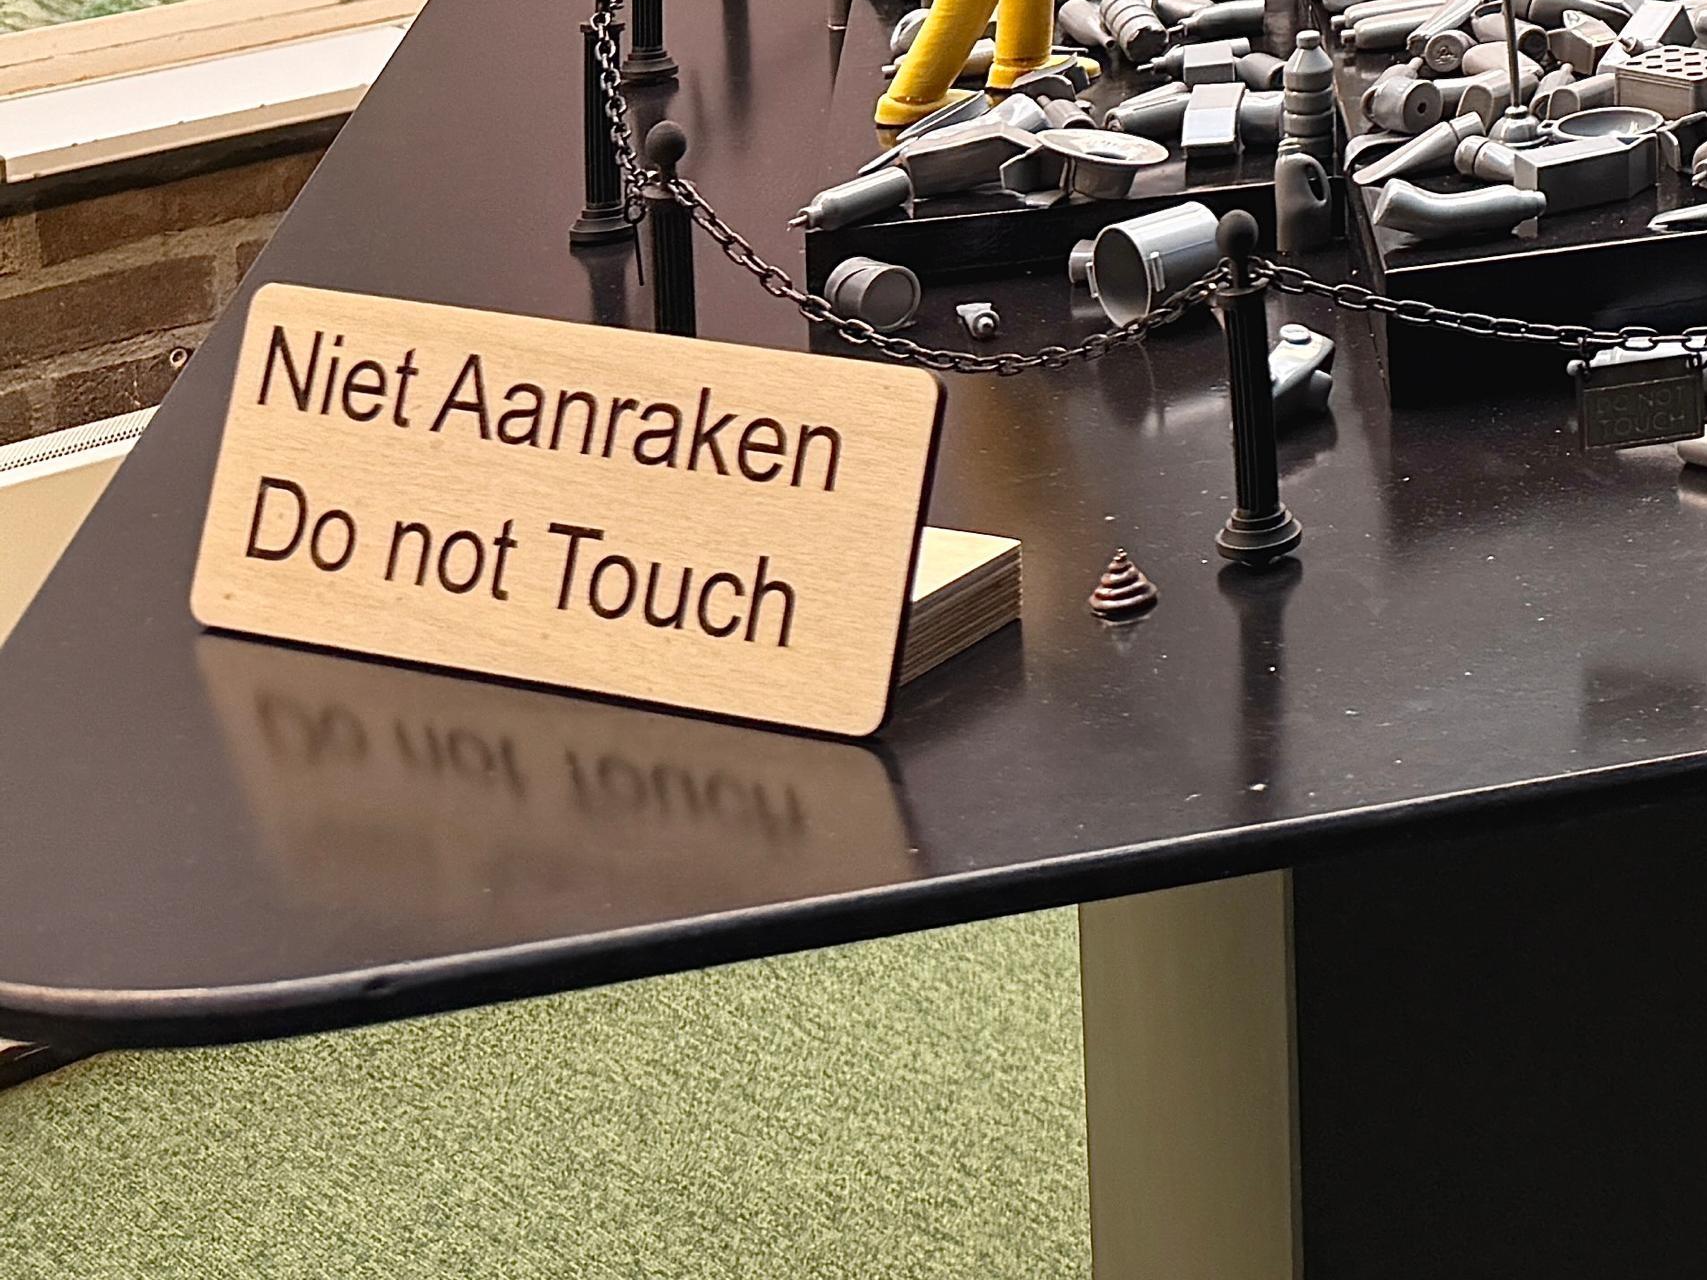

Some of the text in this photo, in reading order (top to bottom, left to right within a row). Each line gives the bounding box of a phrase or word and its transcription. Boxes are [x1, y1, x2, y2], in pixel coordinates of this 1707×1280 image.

[257, 324, 843, 493] Niet Aanraken
[246, 476, 797, 649] Do not Touch
